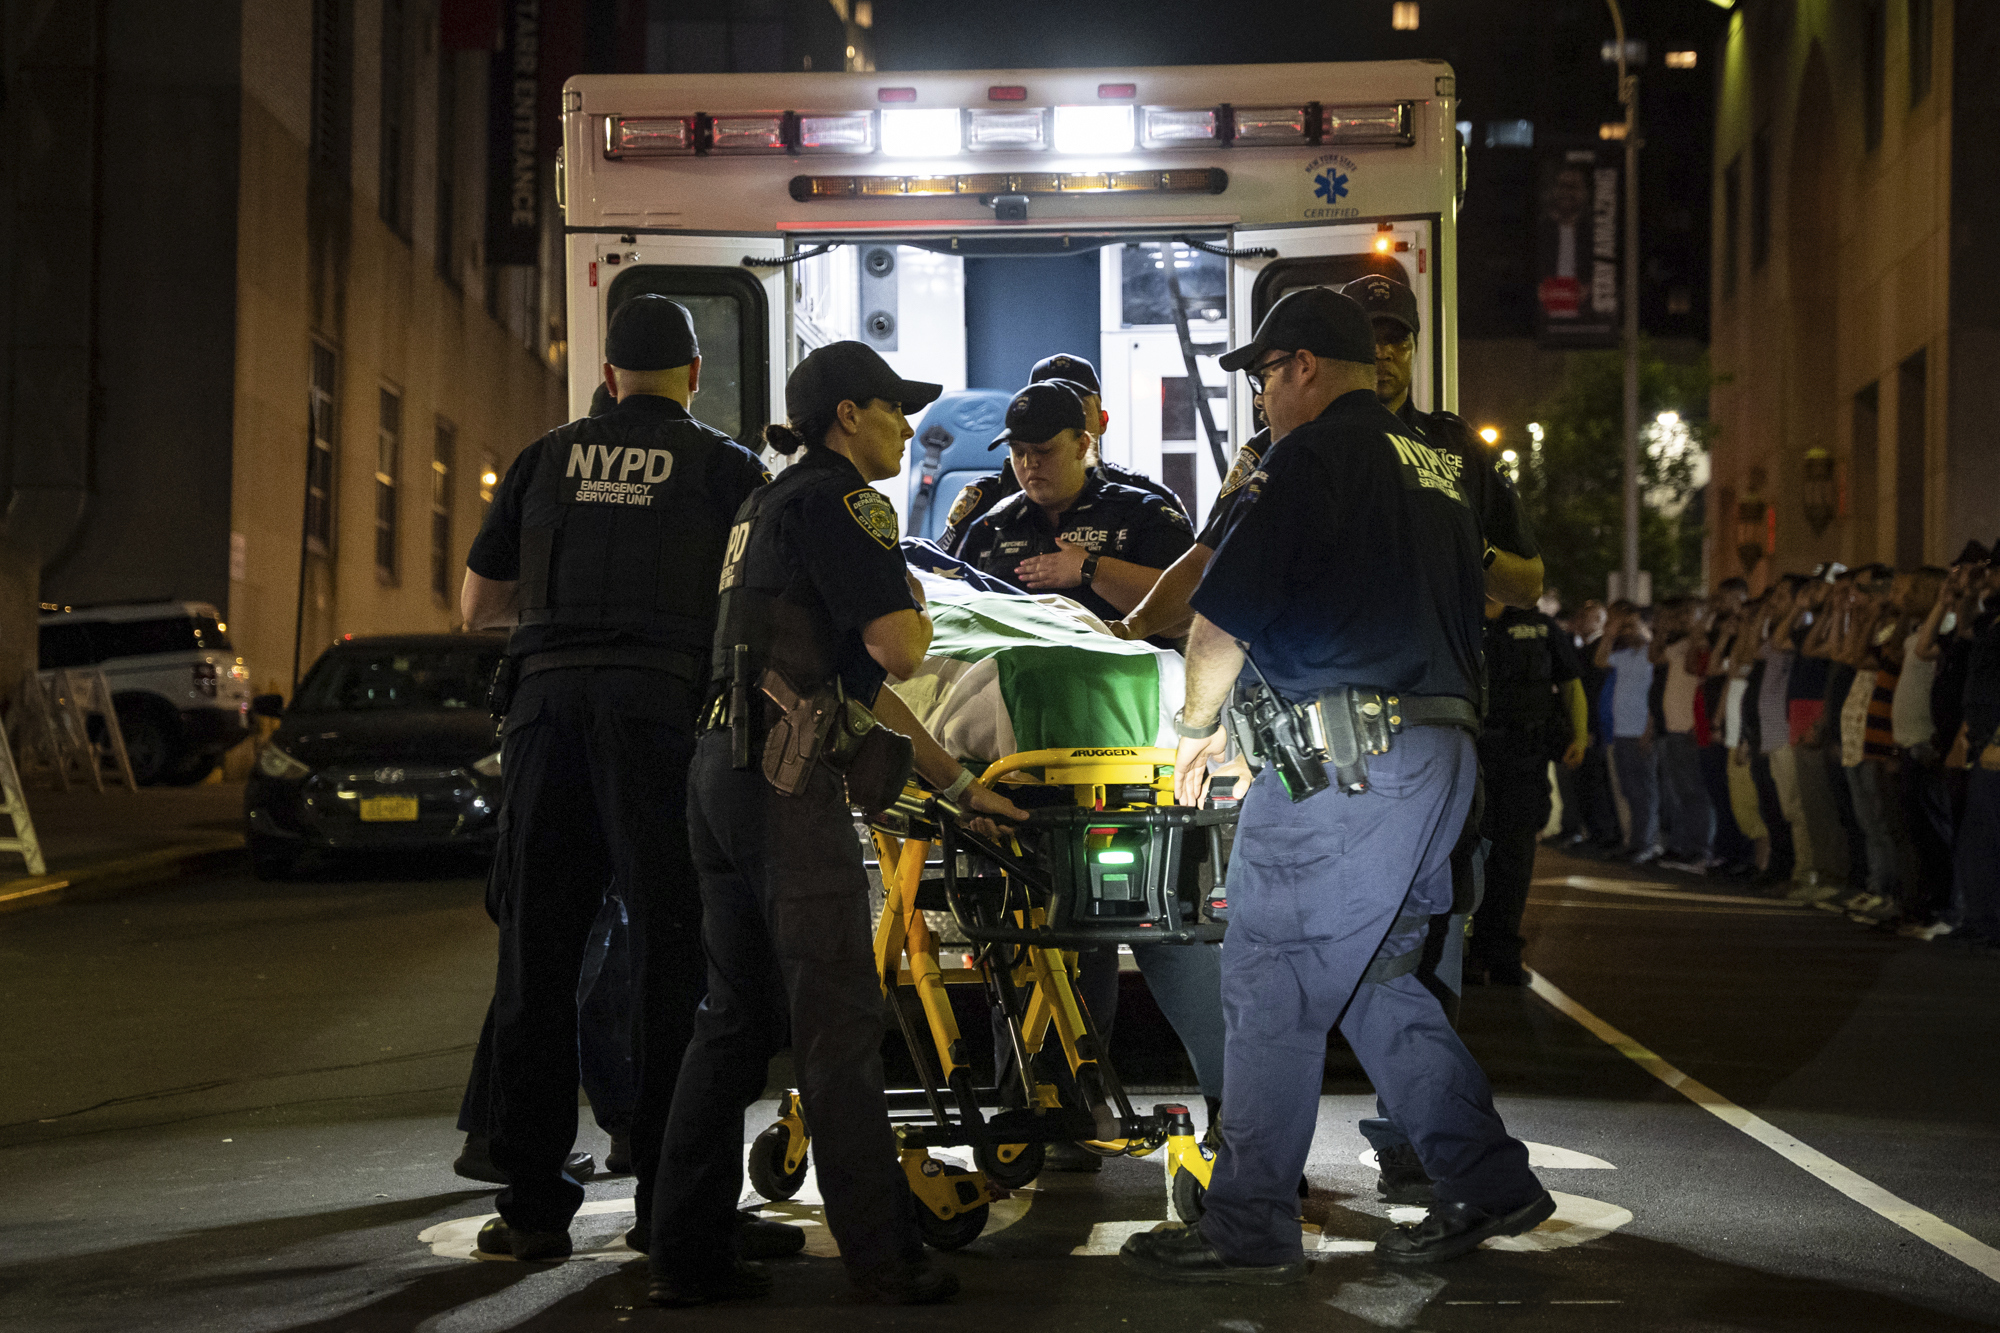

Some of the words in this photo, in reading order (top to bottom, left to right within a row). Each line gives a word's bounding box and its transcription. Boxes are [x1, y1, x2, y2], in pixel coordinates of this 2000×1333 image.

[511, 77, 537, 226] ENTRANCE
[1305, 159, 1319, 173] NEW
[1319, 155, 1338, 167] YORK
[1339, 156, 1357, 172] STATE
[1304, 208, 1359, 218] CERTIFIED
[565, 443, 674, 484] NYPD
[1385, 433, 1455, 481] NYPD
[1441, 452, 1463, 468] ICE
[580, 480, 651, 494] EMERGENCY
[575, 491, 625, 504] SERVICE
[626, 495, 653, 506] UNIT
[858, 492, 881, 500] POLICE
[858, 515, 873, 530] CITY
[871, 529, 882, 538] OF
[1060, 530, 1108, 542] POLICE
[723, 521, 749, 567] PD
[1078, 749, 1130, 757] RUGGED
